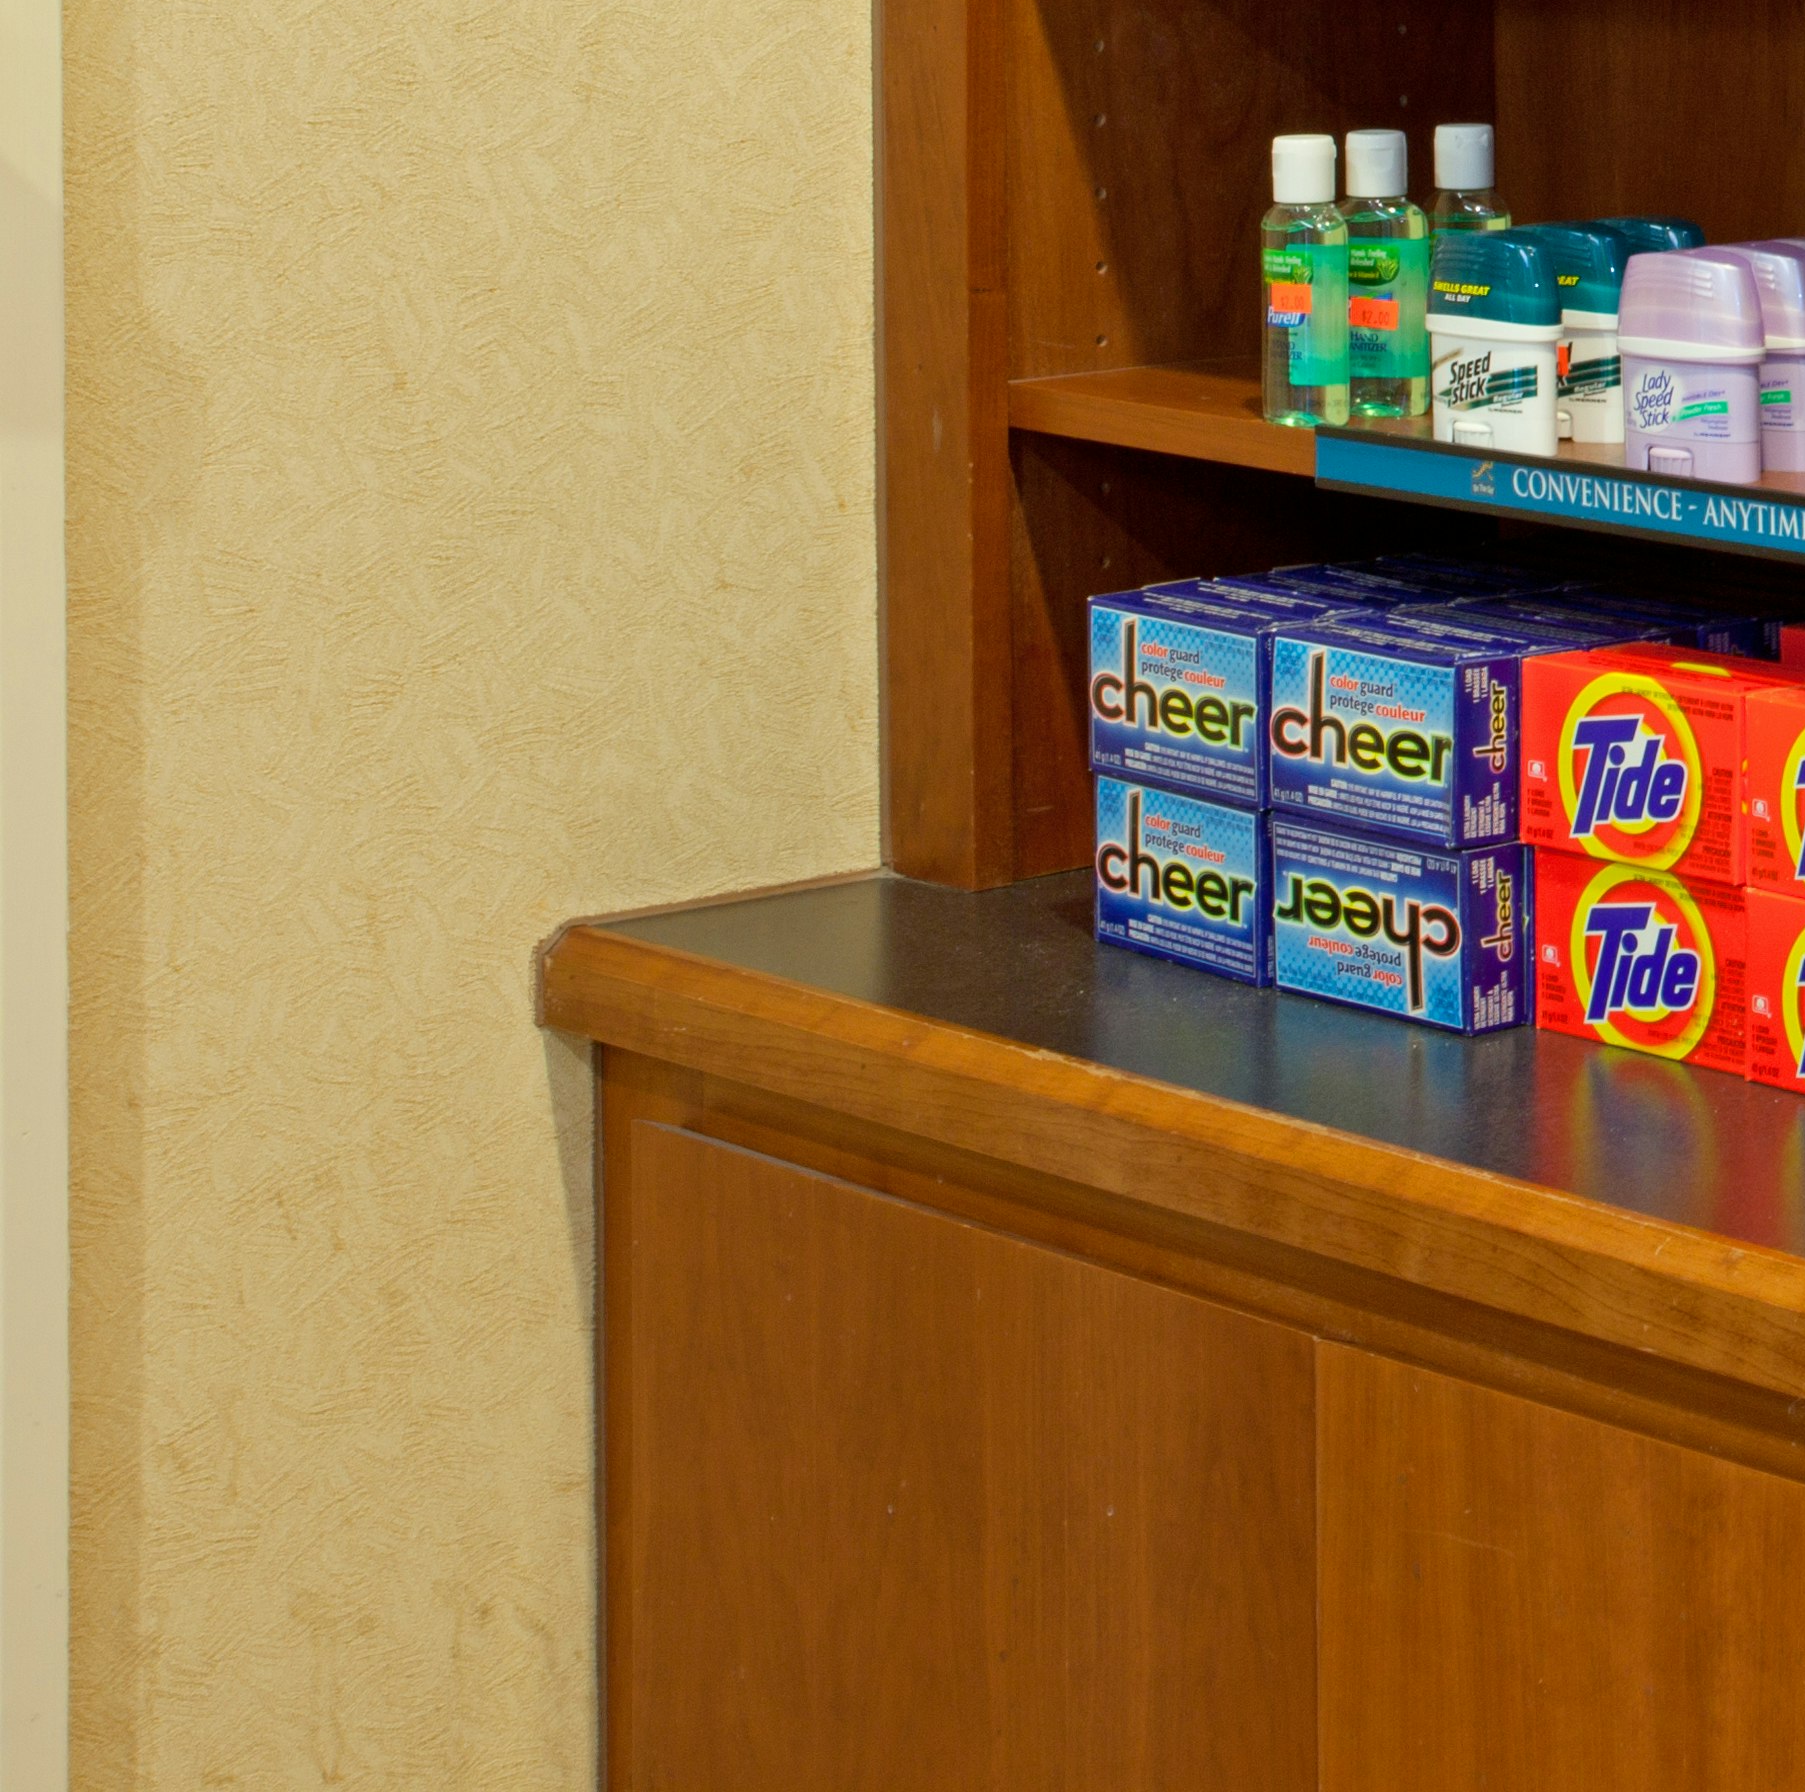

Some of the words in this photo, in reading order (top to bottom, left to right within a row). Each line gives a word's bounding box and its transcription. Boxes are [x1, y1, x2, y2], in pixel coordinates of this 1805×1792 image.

[1432, 280, 1461, 295] SMELLS
[1460, 283, 1491, 297] GREAT
[1449, 351, 1492, 385] Speed
[1641, 370, 1672, 396] Lady
[1634, 386, 1674, 416] Speed
[1639, 407, 1671, 429] Stick
[1512, 466, 1684, 523] CONVENIENCE
[1140, 640, 1168, 658] color
[1169, 648, 1201, 666] guard
[1141, 659, 1183, 684] protege
[1184, 668, 1225, 689] couleur
[1090, 618, 1257, 751] cheer
[1270, 648, 1454, 786] cheer
[1570, 713, 1689, 839] Tide
[1096, 788, 1257, 927] cheer
[1273, 871, 1462, 1015] cheer
[1583, 901, 1702, 1026] Tide
